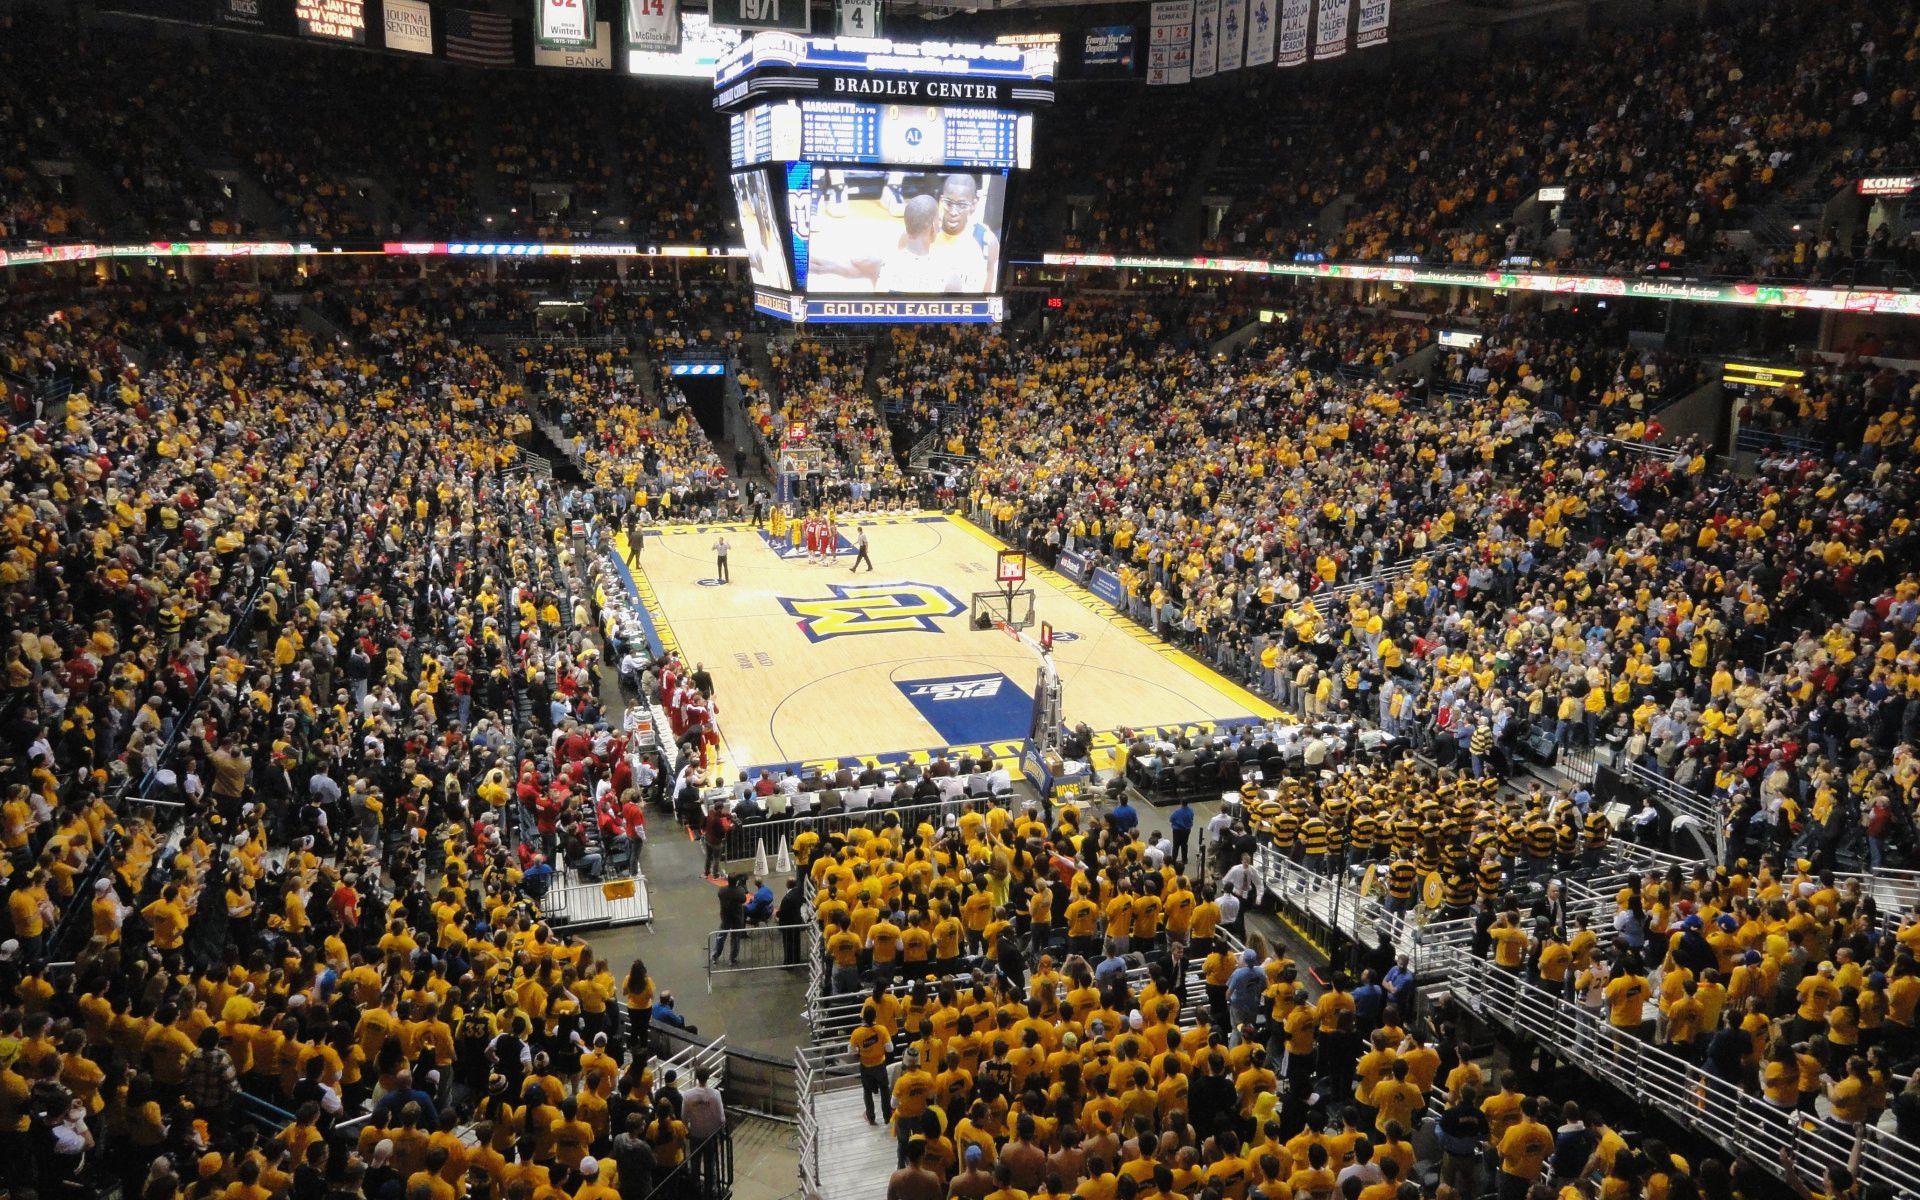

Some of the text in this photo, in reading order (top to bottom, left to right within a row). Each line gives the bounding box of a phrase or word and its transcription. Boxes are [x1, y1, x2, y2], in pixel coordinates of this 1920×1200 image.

[642, 0, 664, 16] 14
[1320, 0, 1346, 12] 2004
[322, 11, 365, 28] VIRGINIA
[386, 9, 430, 26] JOURNAL
[851, 7, 864, 29] 4
[338, 26, 354, 38] AM
[385, 20, 430, 38] SENTINEL
[550, 26, 582, 36] Winters
[1157, 28, 1164, 38] 9
[1176, 27, 1188, 38] 27
[1323, 30, 1340, 41] CUP
[1085, 34, 1132, 45] Energy You Can
[565, 55, 605, 68] BANK
[834, 77, 998, 99] BRADLEY CENTER
[802, 101, 856, 114] MARQUETTE
[889, 105, 937, 122] 0 0
[944, 108, 998, 120] WISCONSIN
[906, 130, 921, 142] AL
[1632, 282, 1720, 300] Old World Family Recipes
[823, 303, 973, 316] GOLDEN EAGLES
[910, 680, 1003, 696] EAST
[932, 688, 998, 700] BIG
